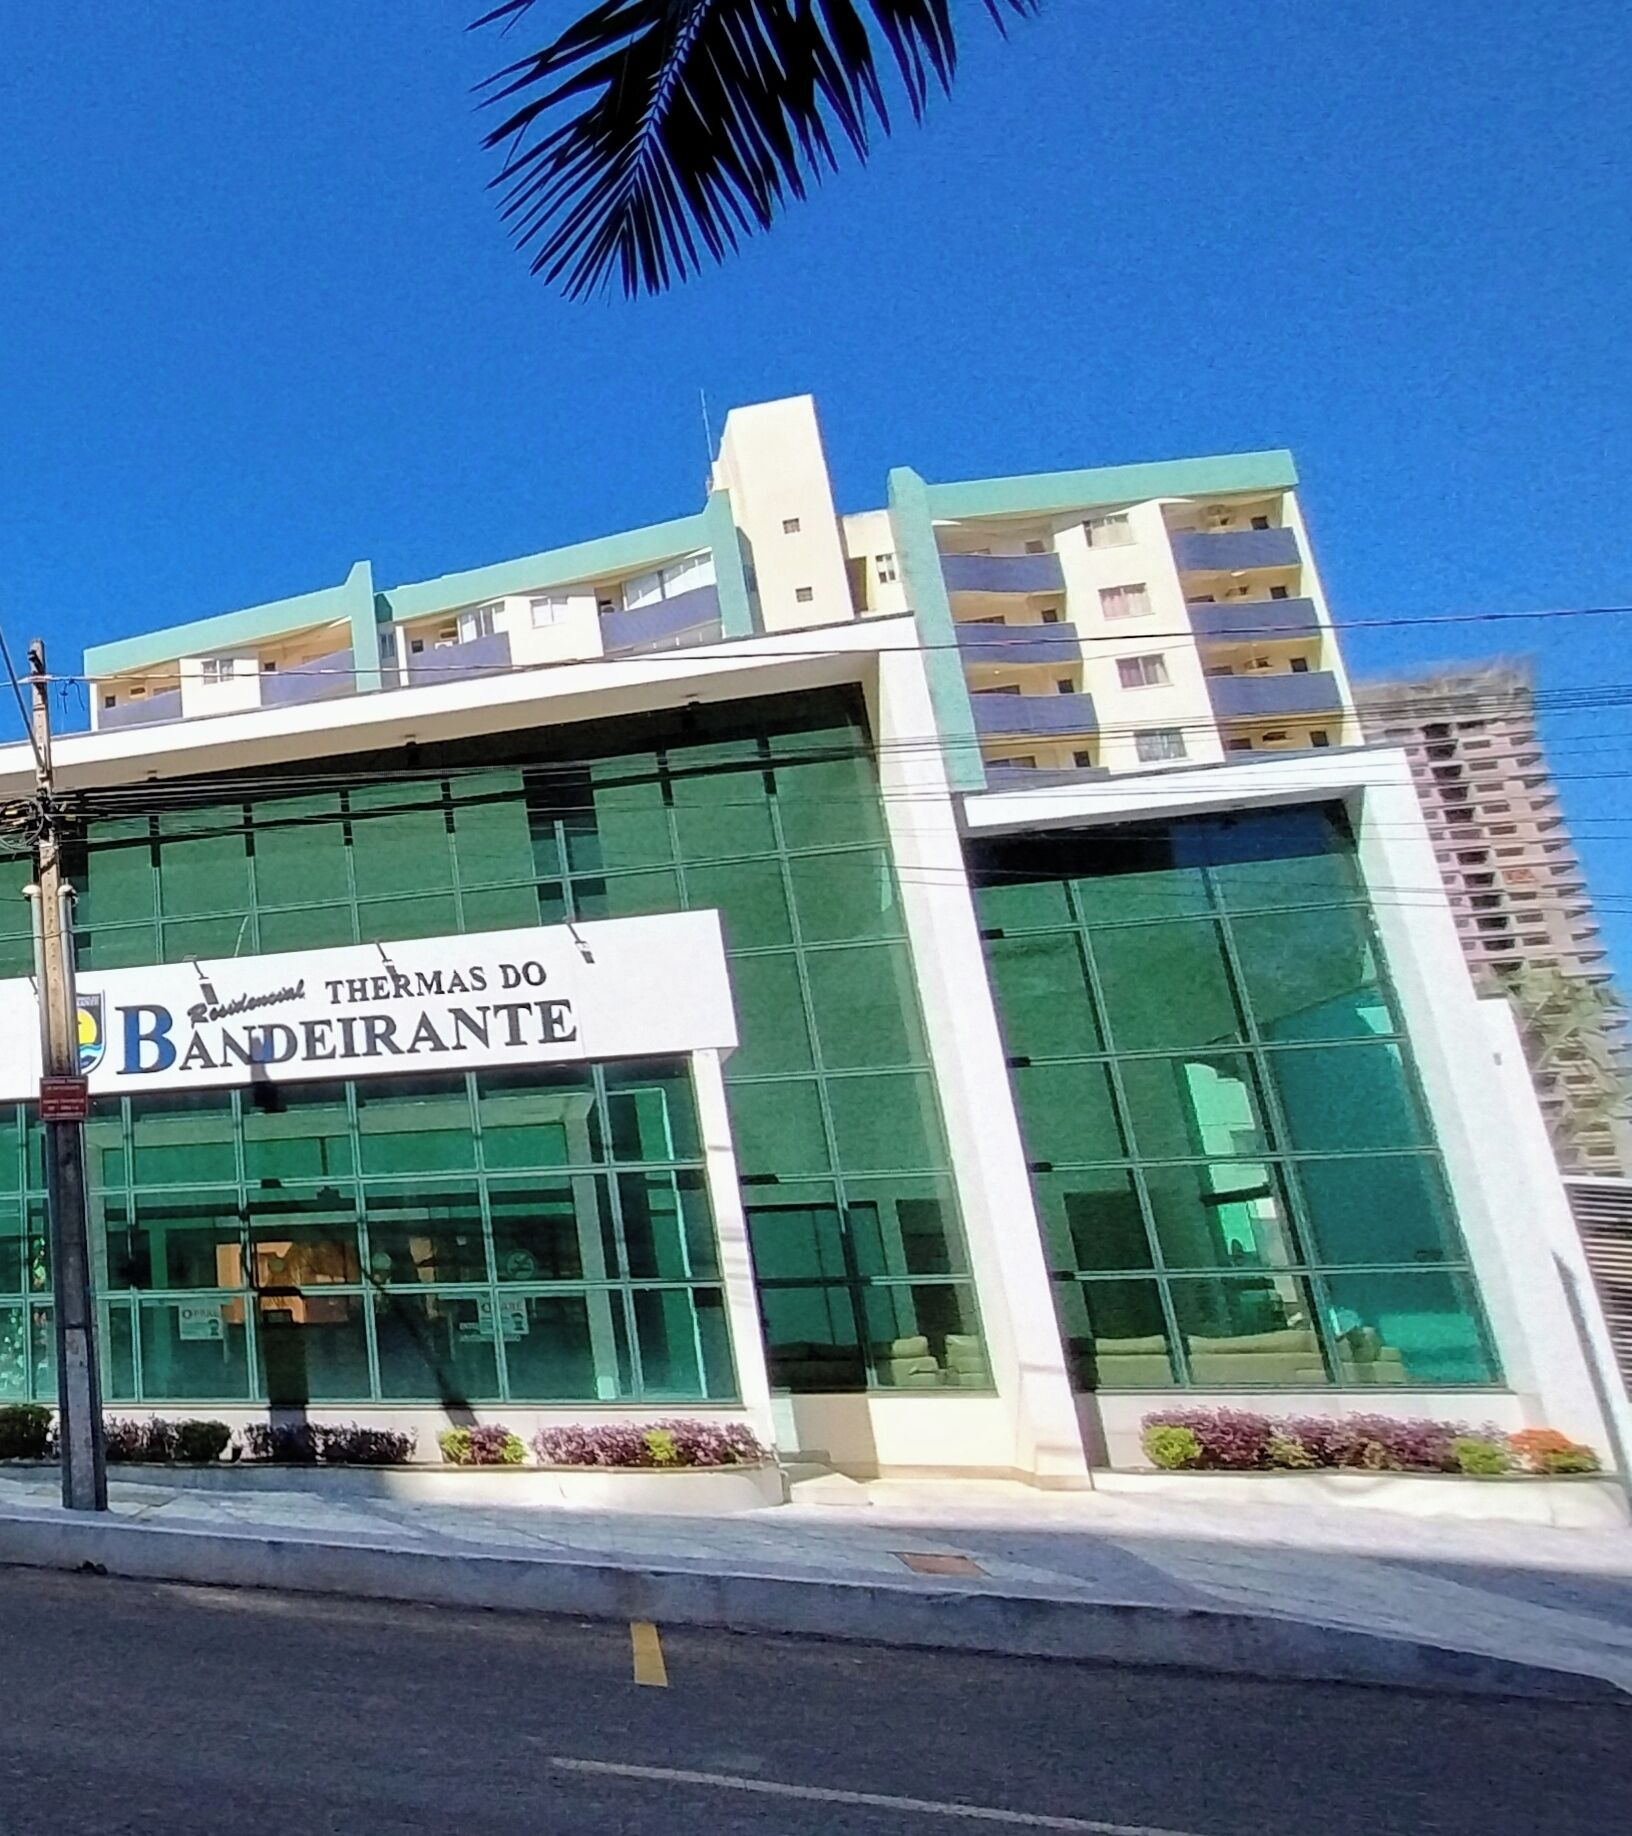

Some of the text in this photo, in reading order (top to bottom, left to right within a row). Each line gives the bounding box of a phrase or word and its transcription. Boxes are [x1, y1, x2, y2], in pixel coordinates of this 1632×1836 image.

[187, 961, 547, 1029] Residencial THERMAS DO
[115, 999, 578, 1075] BANDEIRANTE
